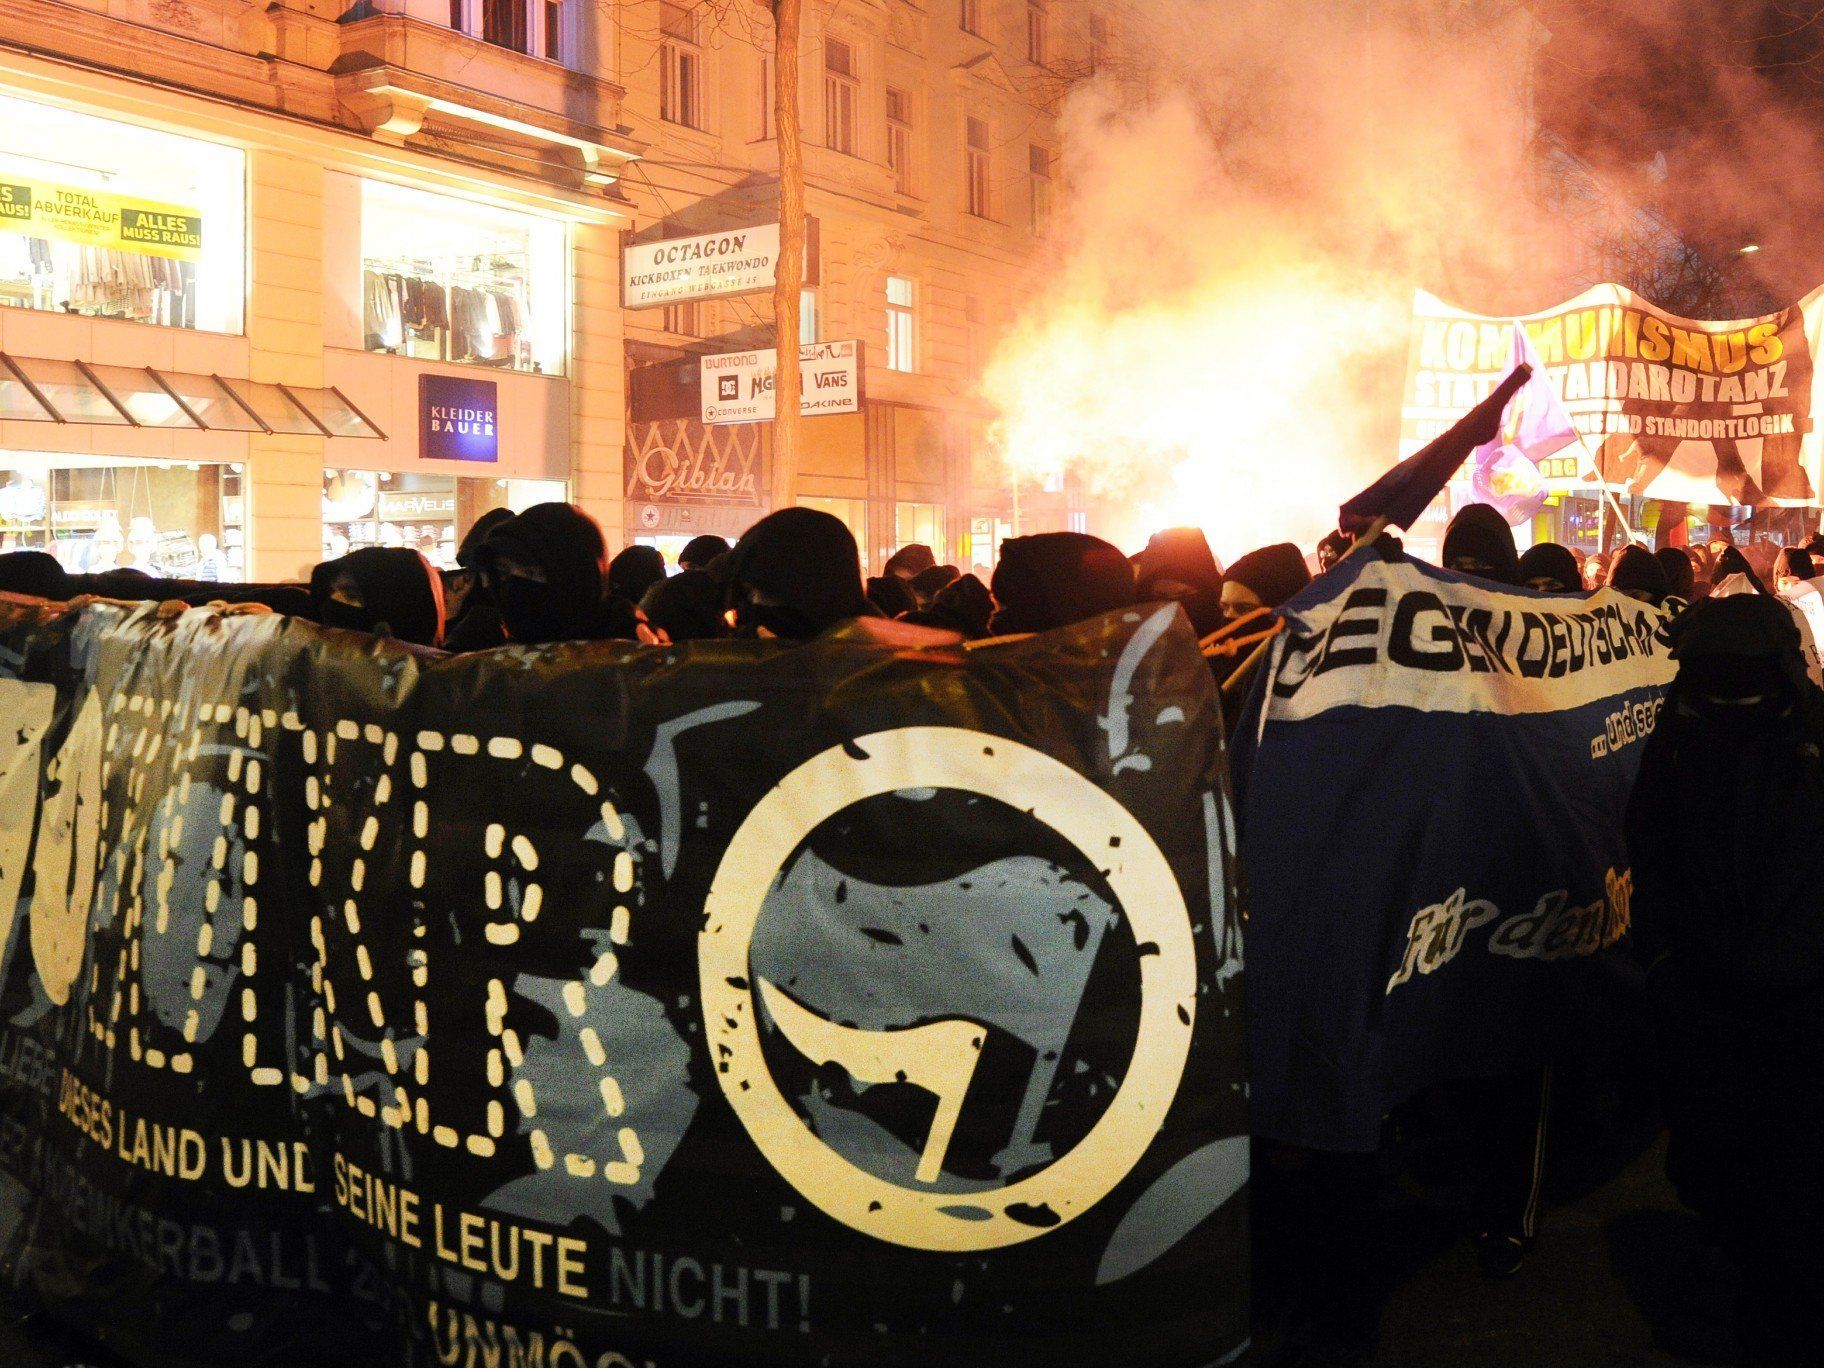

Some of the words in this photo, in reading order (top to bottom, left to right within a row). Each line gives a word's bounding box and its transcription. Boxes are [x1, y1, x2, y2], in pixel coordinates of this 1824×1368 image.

[56, 190, 98, 208] TOTAL
[35, 200, 120, 223] ABVERKAUF
[137, 213, 188, 232] ALLES
[123, 226, 160, 241] MUSS
[162, 230, 201, 246] RAUS!
[654, 234, 747, 265] OCTAGON
[630, 267, 692, 287] KICKBOXEN
[699, 256, 769, 277] TAEKWONDO
[705, 356, 749, 370] BURTON
[814, 370, 848, 389] VANS
[432, 406, 494, 423] KLEIDER
[718, 406, 757, 416] CONVERSE
[432, 420, 494, 436] BAUER
[1645, 413, 1795, 439] STANDORTLOGIK
[118, 1109, 207, 1182] LAND
[333, 1152, 422, 1248] SEINE
[435, 1203, 589, 1298] LEUTE
[610, 1246, 811, 1334] NICHT!
